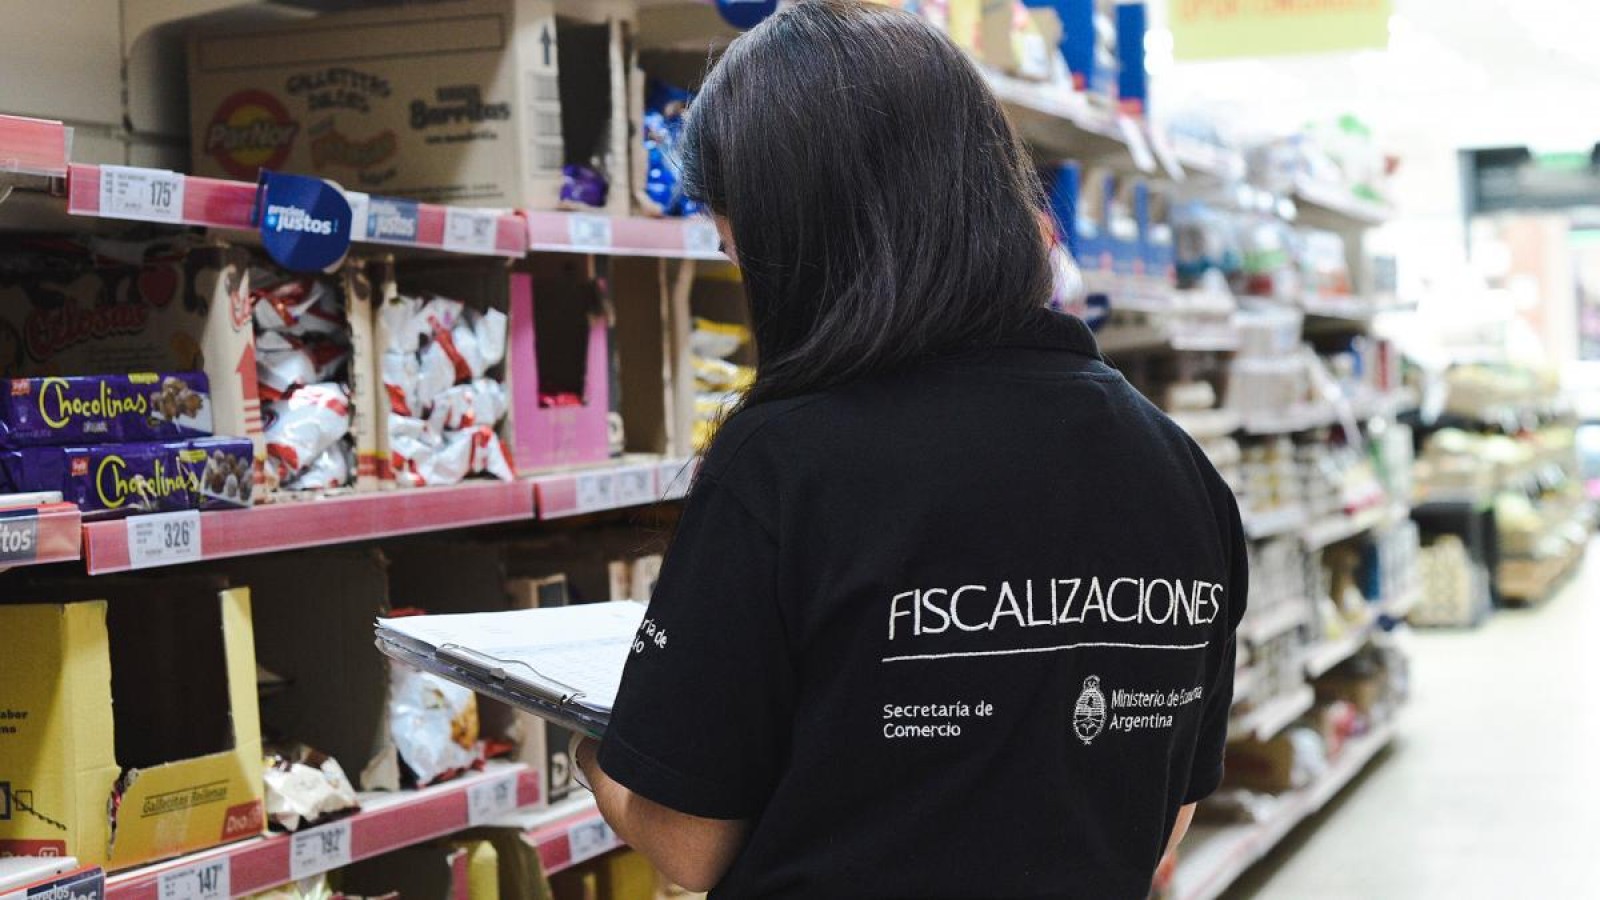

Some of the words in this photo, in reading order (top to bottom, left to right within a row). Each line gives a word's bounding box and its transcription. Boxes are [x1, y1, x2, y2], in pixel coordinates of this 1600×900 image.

[151, 180, 171, 208] 175
[40, 377, 147, 429] Chocolinas
[0, 523, 32, 552] tos
[164, 520, 190, 548] 326
[888, 576, 1223, 640] FISCALIZACIONES
[883, 700, 970, 718] Secretaría
[976, 700, 993, 717] de
[1111, 689, 1166, 709] Ministerio
[1167, 689, 1180, 707] de
[883, 723, 961, 740] Comercio
[1109, 713, 1173, 732] Argentina
[197, 864, 218, 894] 147
